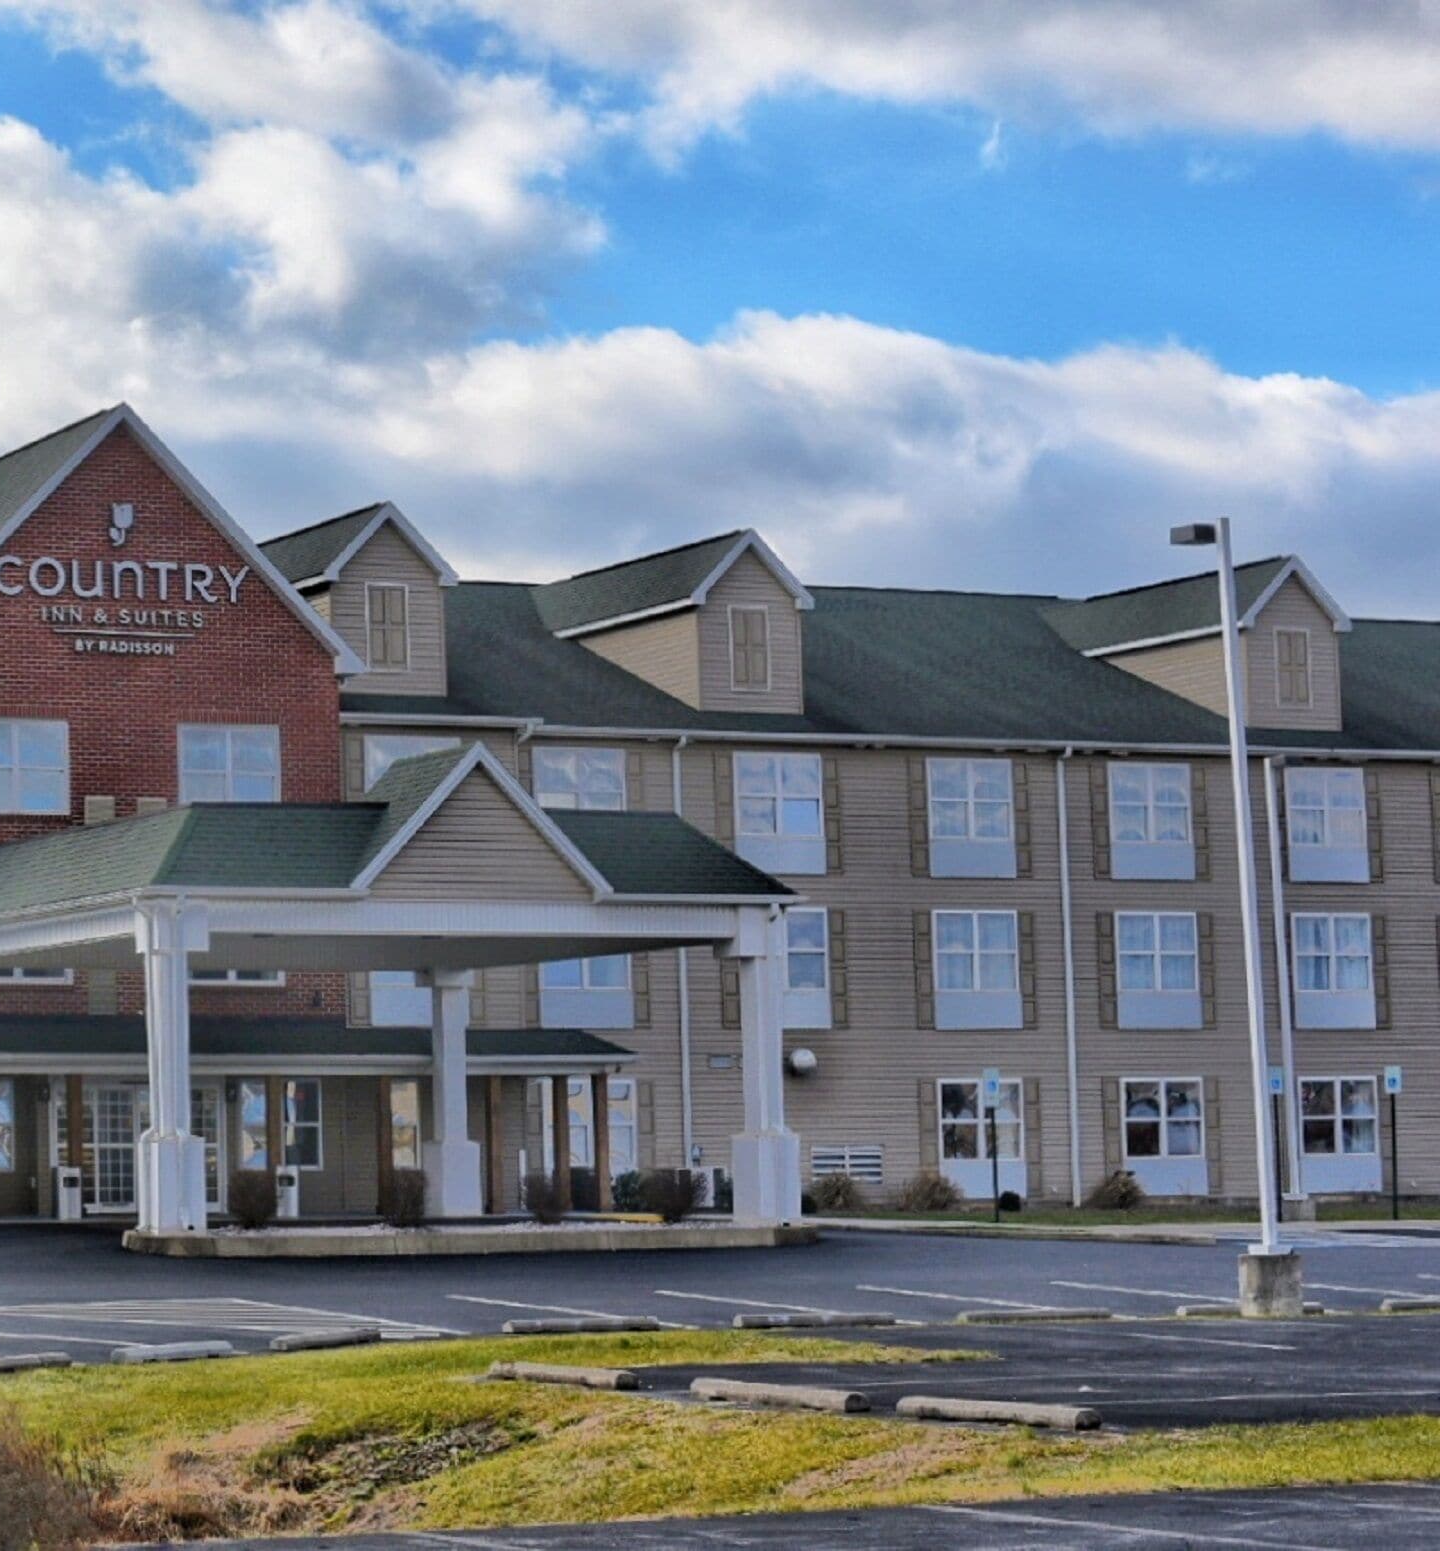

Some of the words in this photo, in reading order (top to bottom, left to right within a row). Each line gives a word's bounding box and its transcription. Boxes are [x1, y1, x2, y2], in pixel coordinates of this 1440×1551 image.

[42, 606, 82, 622] INN
[93, 609, 108, 624] &
[119, 609, 204, 627] SUITES
[75, 639, 92, 651] BY
[98, 640, 175, 655] RADISSON
